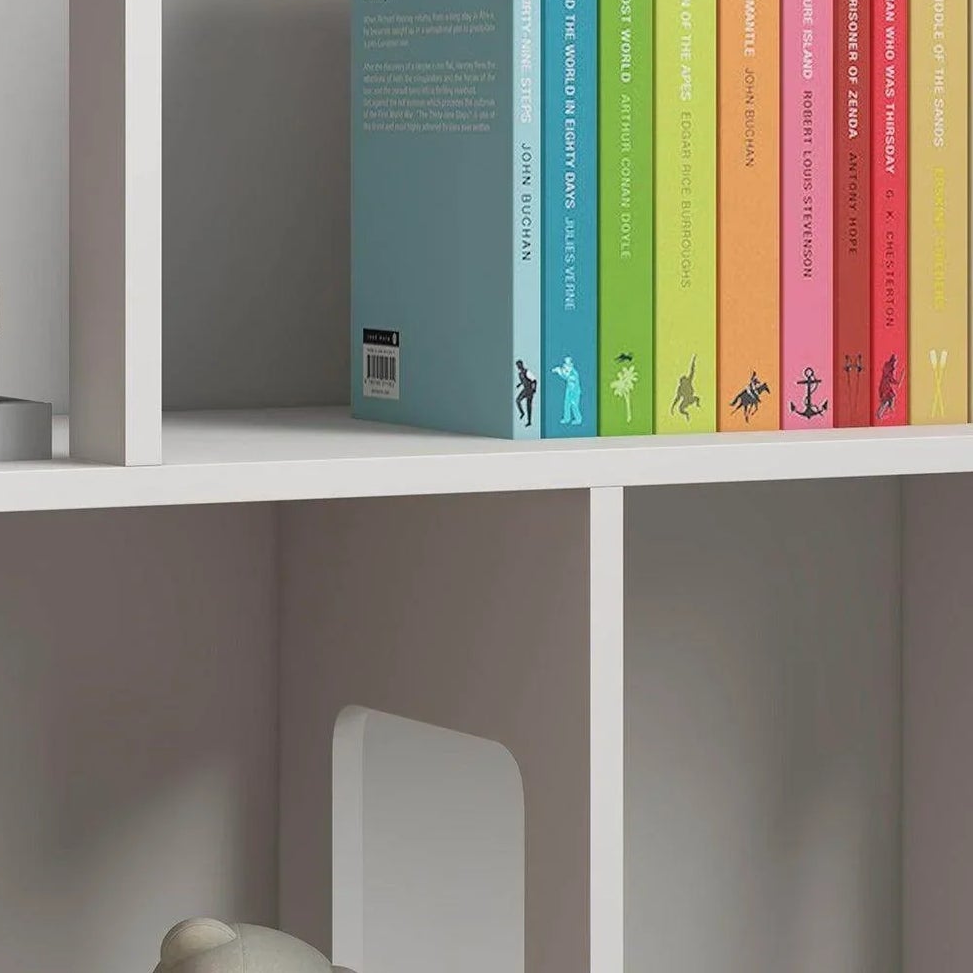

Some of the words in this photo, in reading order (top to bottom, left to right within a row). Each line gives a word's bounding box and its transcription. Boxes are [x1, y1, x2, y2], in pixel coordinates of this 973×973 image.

[565, 14, 576, 41] THE
[680, 11, 692, 29] OF
[621, 28, 632, 83] WORLD
[680, 35, 692, 59] THE
[803, 30, 813, 79] ISLAND
[885, 26, 895, 60] WHO
[934, 44, 944, 61] OF
[565, 44, 576, 95] WORLD
[680, 65, 692, 100] APES
[745, 67, 755, 104] JOHN
[848, 66, 858, 84] OF
[885, 66, 895, 97] WAS
[934, 69, 944, 91] THE
[520, 78, 532, 123] STEPS
[565, 100, 576, 114] IN
[620, 94, 631, 152] ARTHUR
[803, 90, 813, 144] ROBERT
[848, 90, 858, 138] ZENDA
[934, 98, 944, 147] SANDS
[564, 119, 576, 167] EIGHTY
[681, 112, 691, 158] EDGAR
[745, 110, 755, 167] BUCHAN
[522, 143, 532, 185] JOHN
[620, 157, 631, 208] CONAN
[681, 164, 691, 195] RICE
[803, 150, 813, 190] LOUIS
[848, 152, 858, 210] ANTONY
[564, 172, 576, 208] DAYS
[522, 194, 532, 261] BUCHAN
[620, 213, 631, 259] DOYLE
[681, 200, 691, 288] BURROUGHS
[803, 196, 813, 278] STEVENSON
[848, 217, 858, 255] HOPE
[564, 266, 575, 311] VERNE
[885, 231, 894, 328] CHESTERTON
